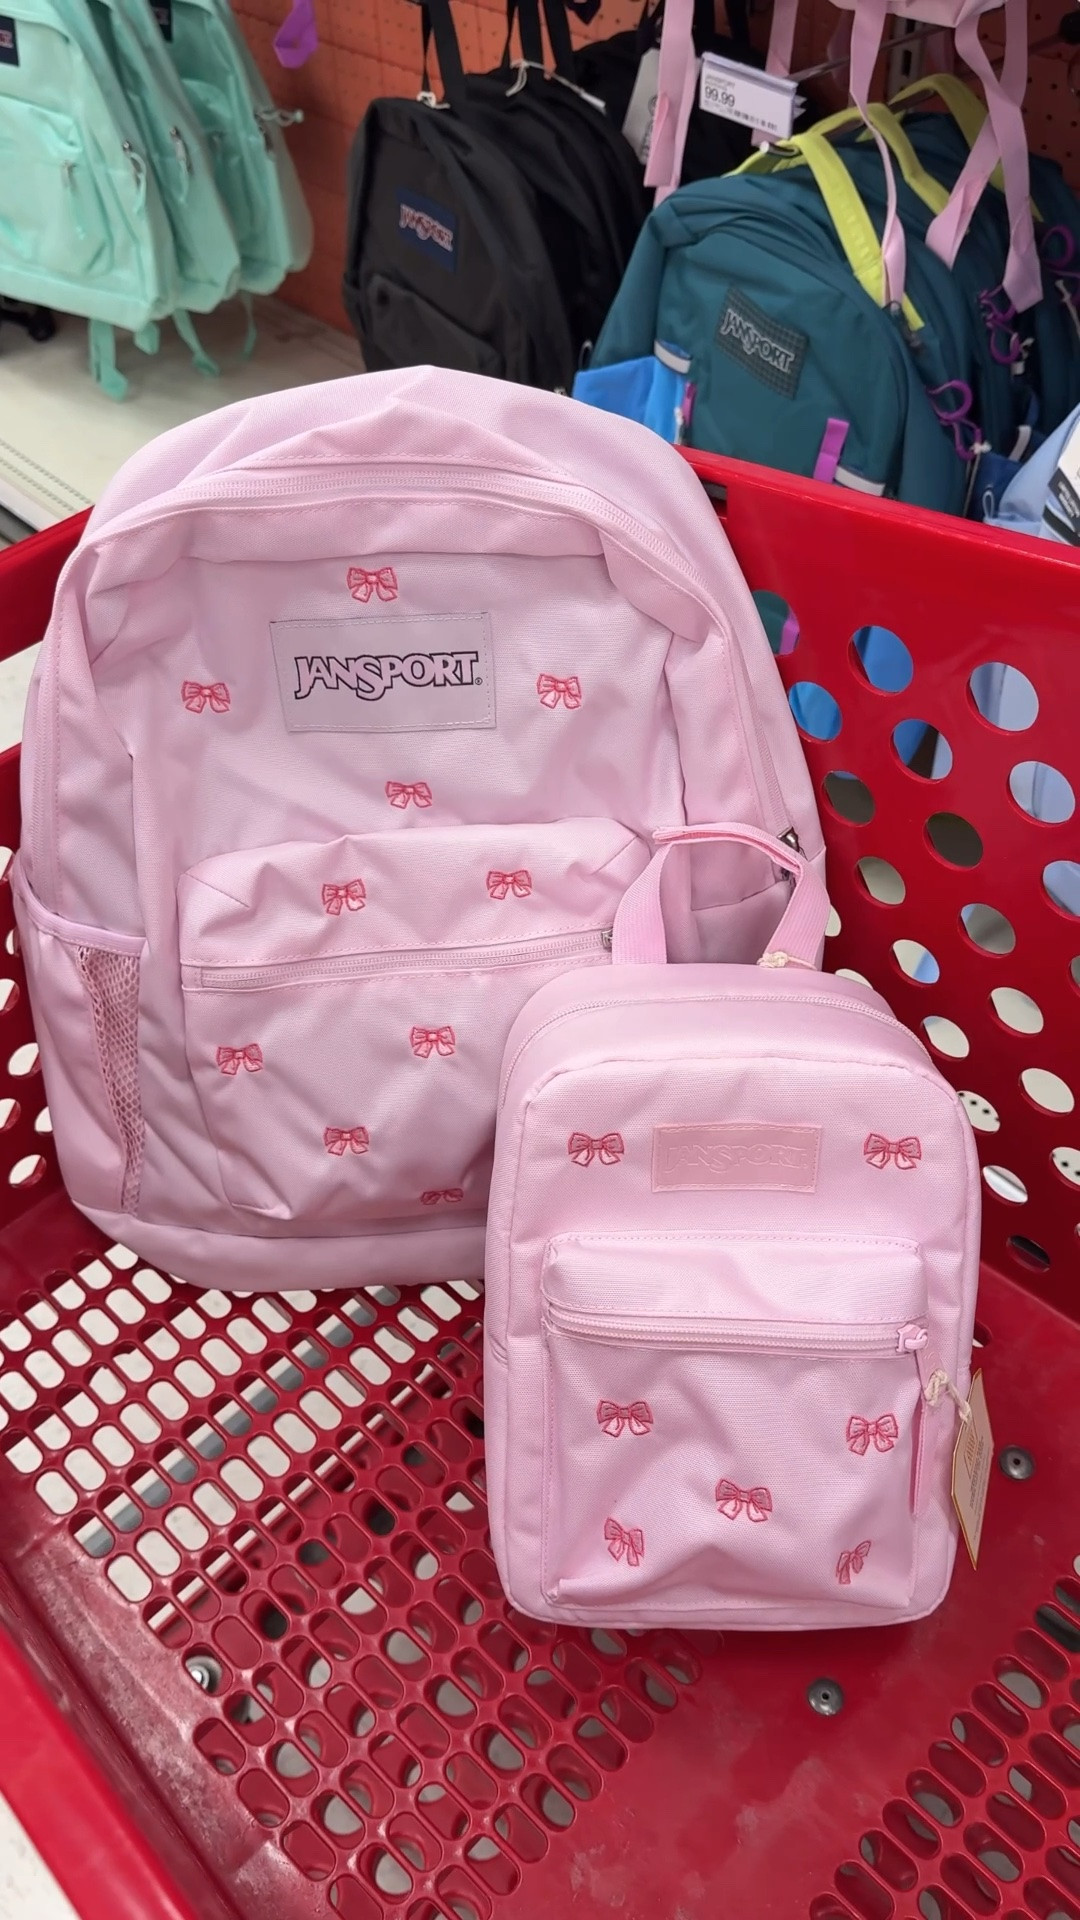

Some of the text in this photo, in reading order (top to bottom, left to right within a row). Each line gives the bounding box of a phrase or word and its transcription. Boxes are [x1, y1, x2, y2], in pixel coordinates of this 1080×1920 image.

[704, 85, 736, 108] 99.99
[720, 308, 795, 374] JANSPORT
[663, 1143, 808, 1174] JANSPORT
